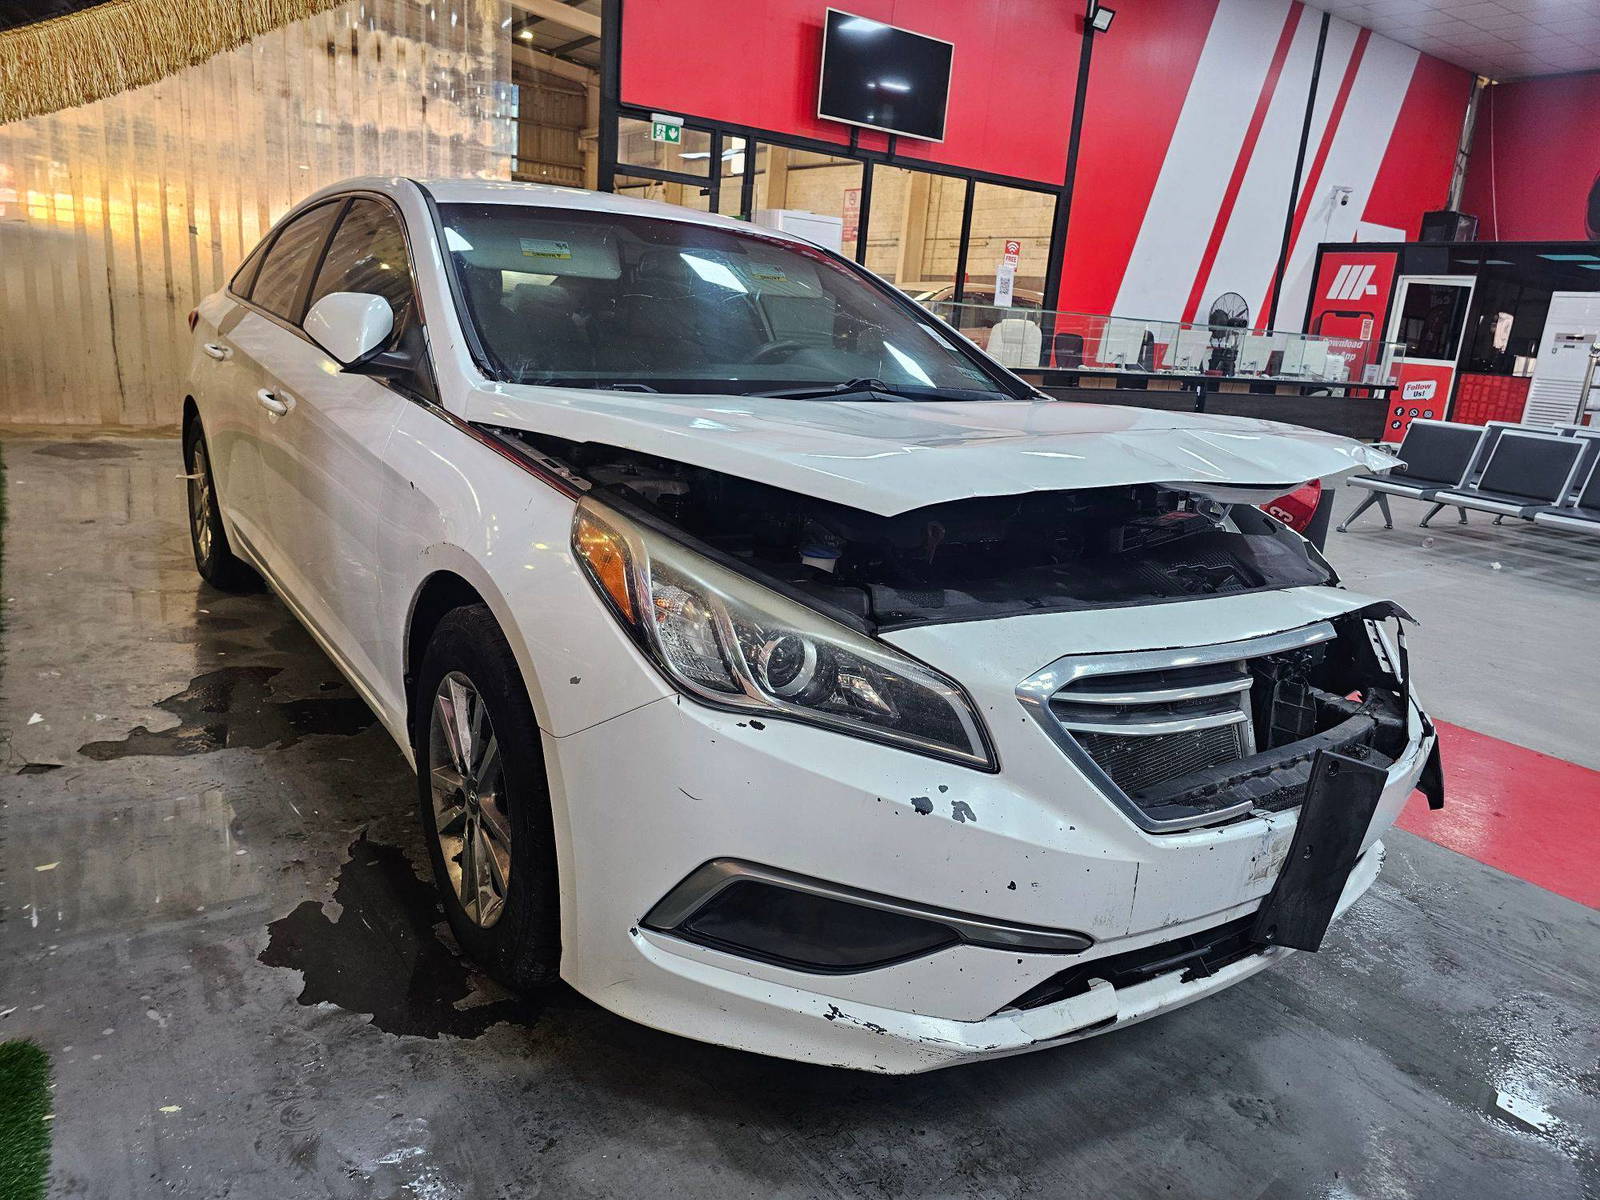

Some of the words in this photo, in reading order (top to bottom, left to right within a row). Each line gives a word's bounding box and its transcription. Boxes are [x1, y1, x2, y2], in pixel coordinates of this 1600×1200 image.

[1005, 255, 1018, 264] FREE
[1406, 383, 1432, 391] Follow
[1269, 506, 1294, 523] 3
